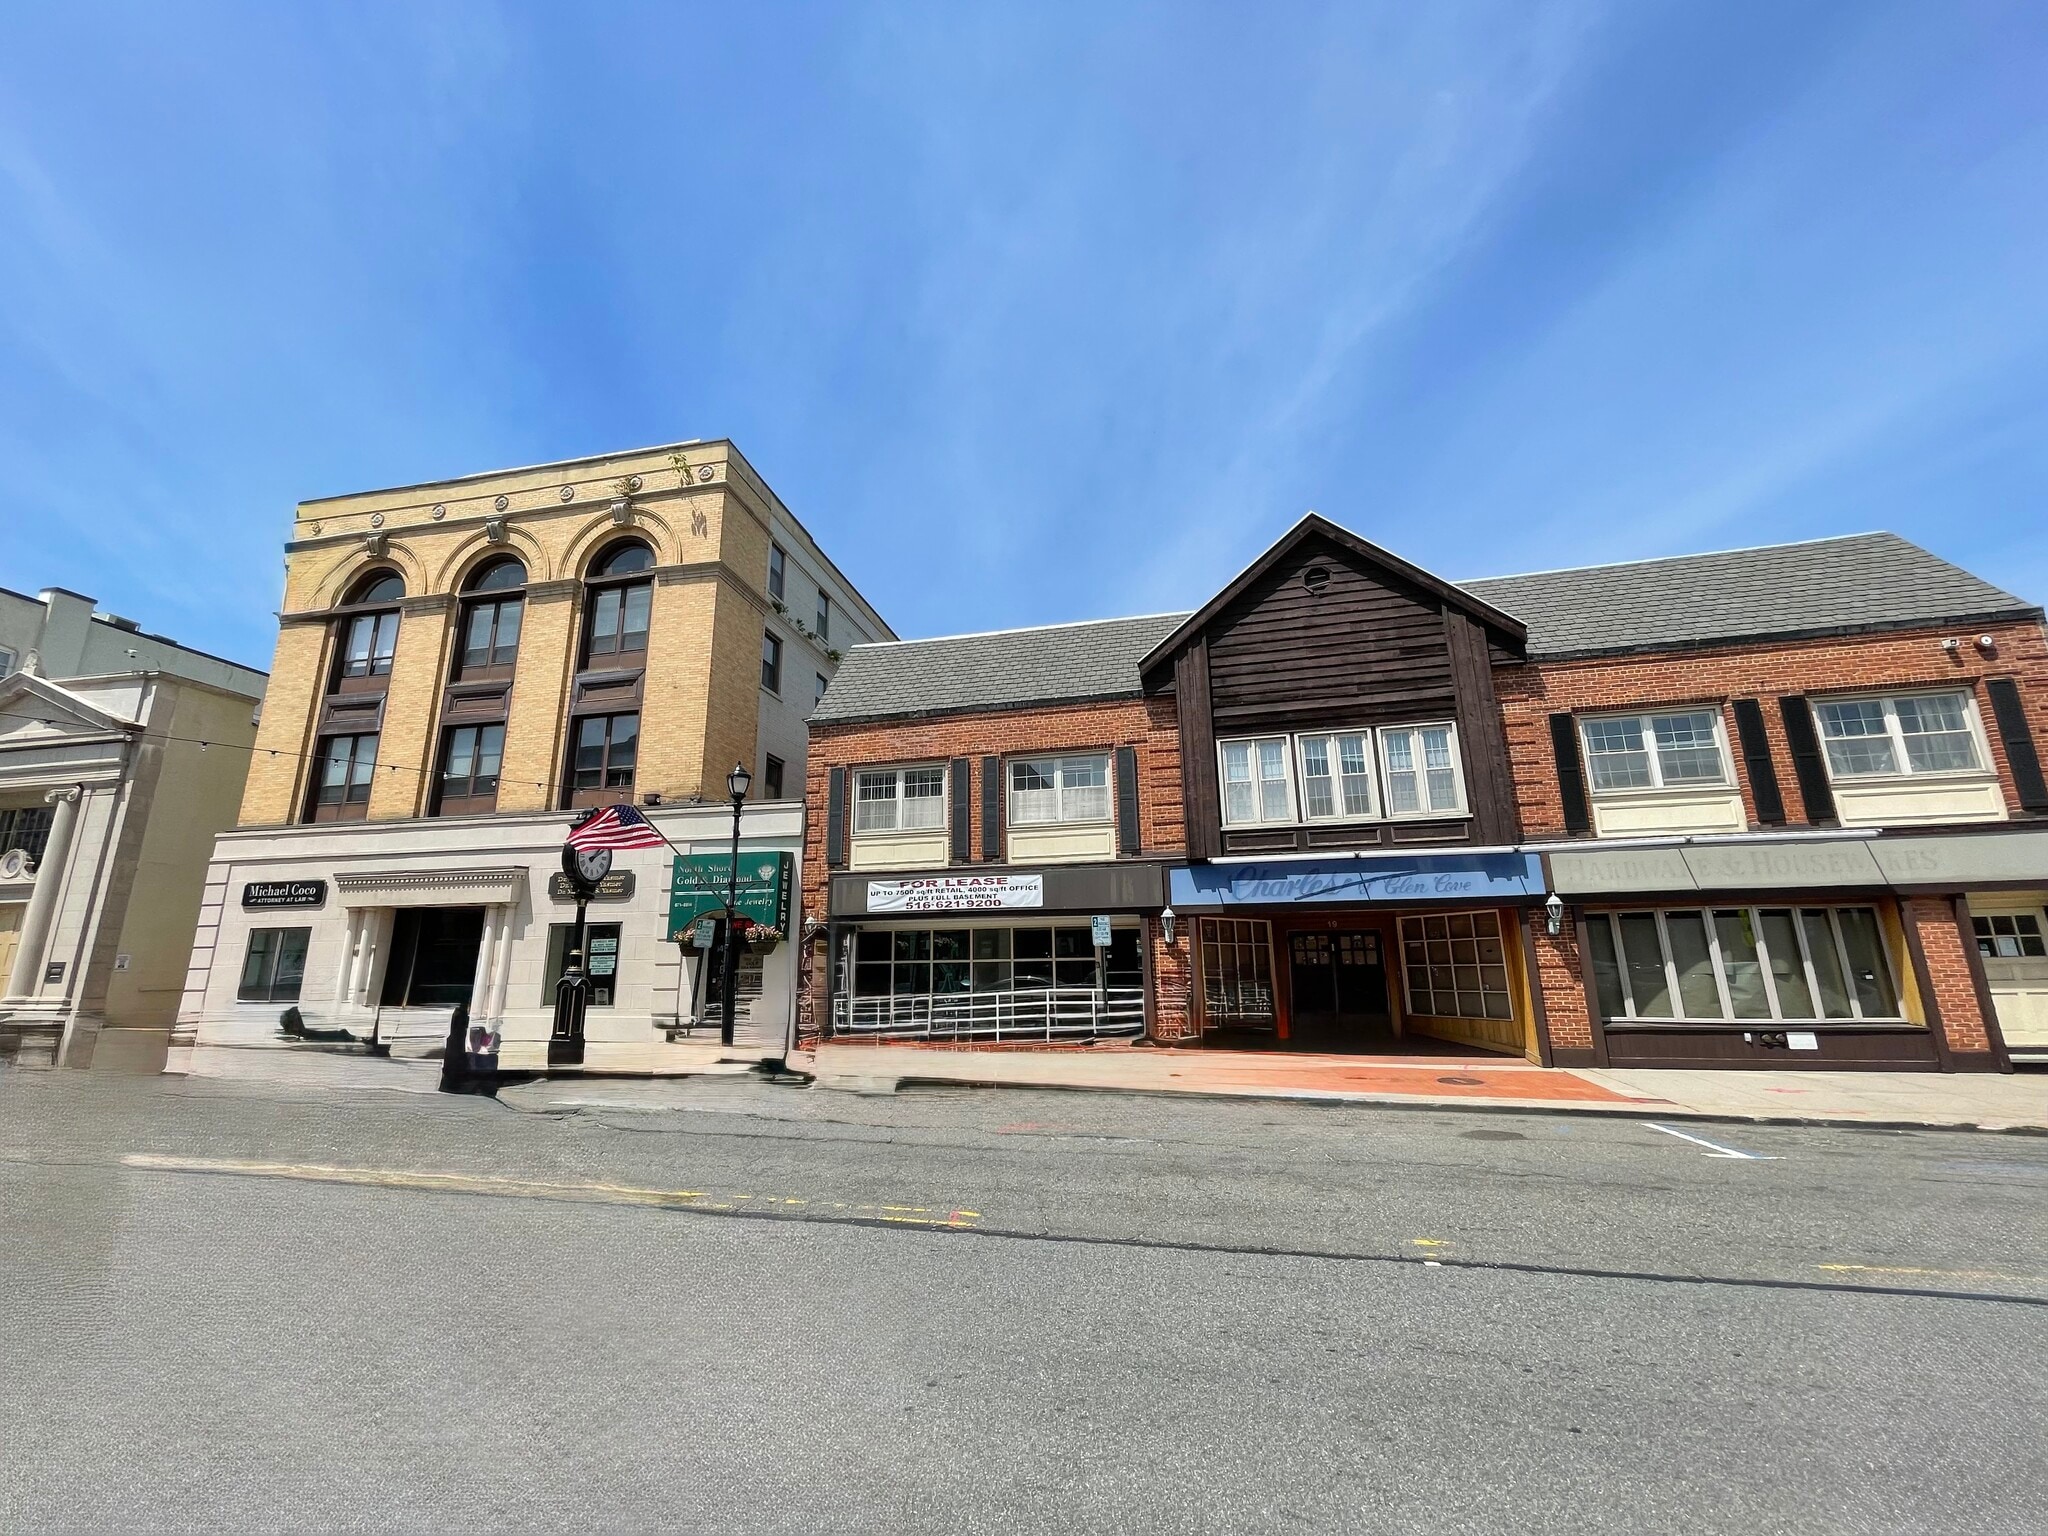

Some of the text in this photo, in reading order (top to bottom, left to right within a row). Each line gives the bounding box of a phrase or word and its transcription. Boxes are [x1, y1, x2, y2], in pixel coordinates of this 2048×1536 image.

[677, 876, 698, 885] Gold
[899, 877, 1009, 888] FOR LEASE
[1384, 877, 1429, 895] Glen
[1434, 873, 1472, 893] Cove
[249, 884, 316, 897] Michael Coco
[779, 861, 789, 932] JEWELRY
[744, 898, 773, 907] Jewelry
[906, 899, 1002, 910] 516-621-9200
[1327, 920, 1338, 928] 19
